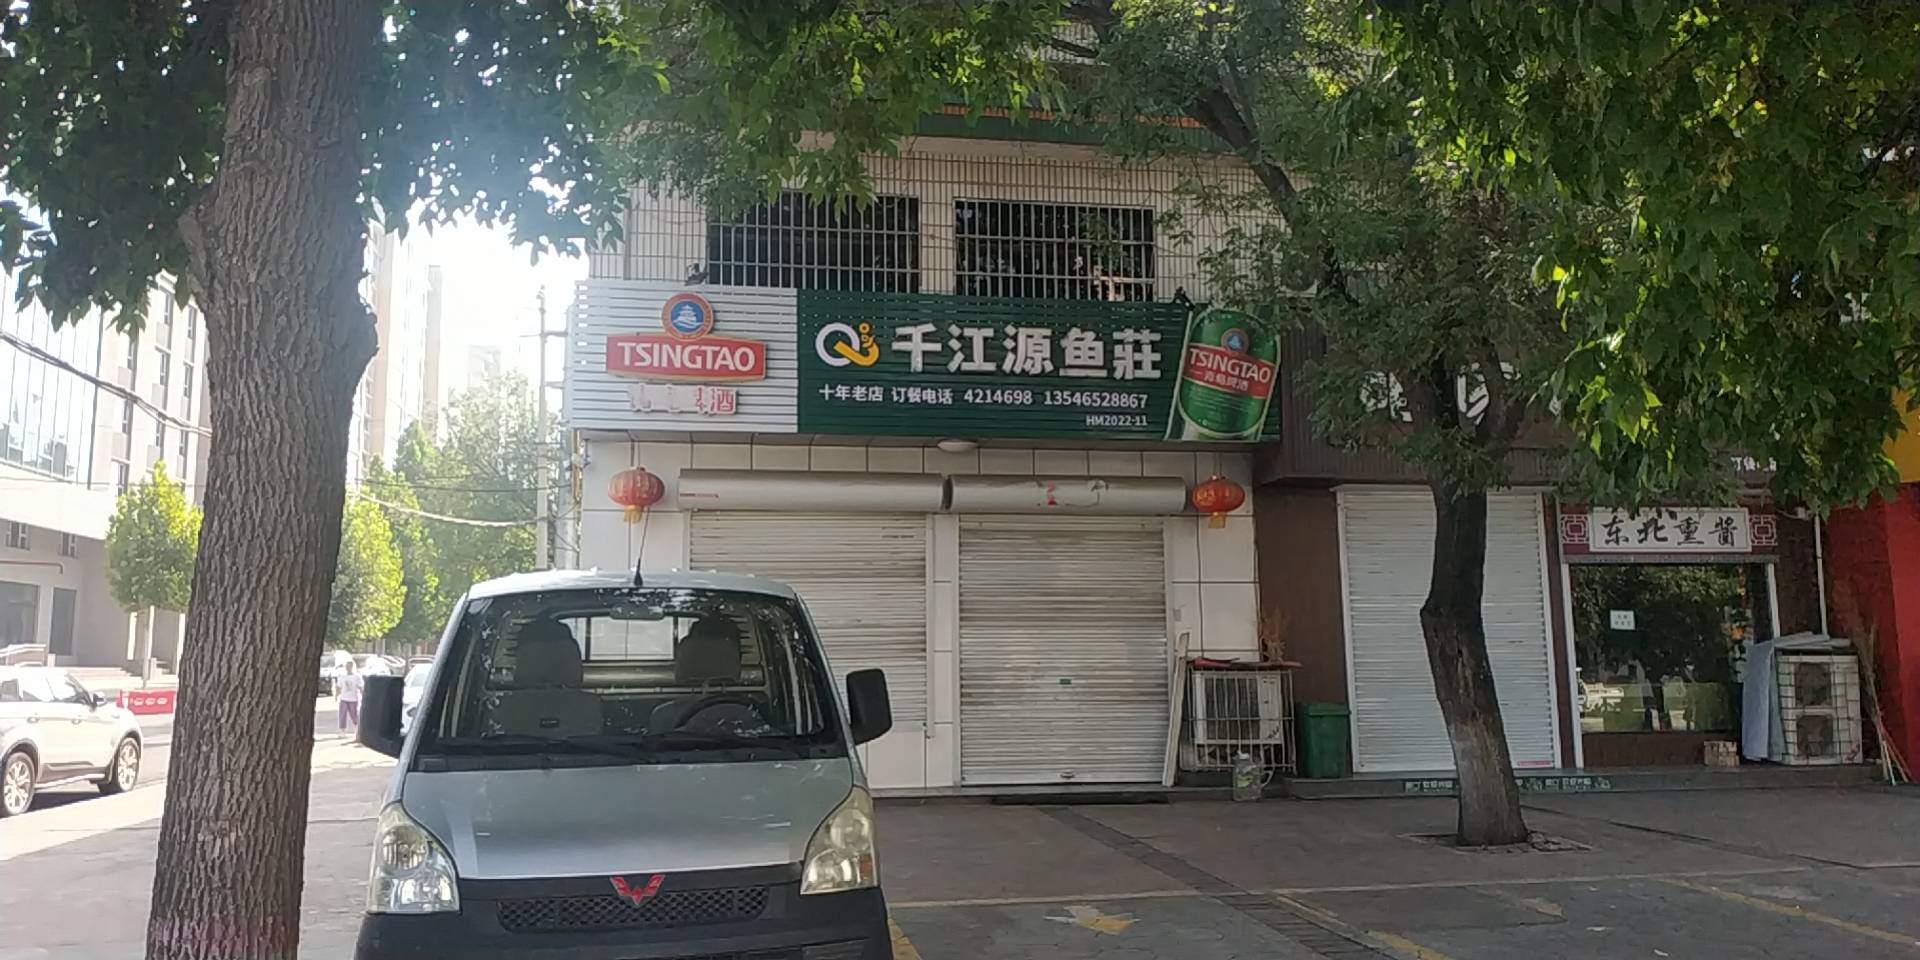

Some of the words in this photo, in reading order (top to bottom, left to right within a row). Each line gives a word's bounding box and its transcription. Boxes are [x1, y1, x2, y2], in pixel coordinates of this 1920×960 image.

[617, 342, 755, 371] TSINGTAO
[1189, 348, 1272, 384] TSINGTAO
[819, 384, 884, 402] 十年老店
[892, 387, 954, 405] 订餐电话
[964, 390, 1034, 405] 4214698
[1044, 391, 1149, 408] 13546528867
[1086, 414, 1148, 427] HM2022-11
